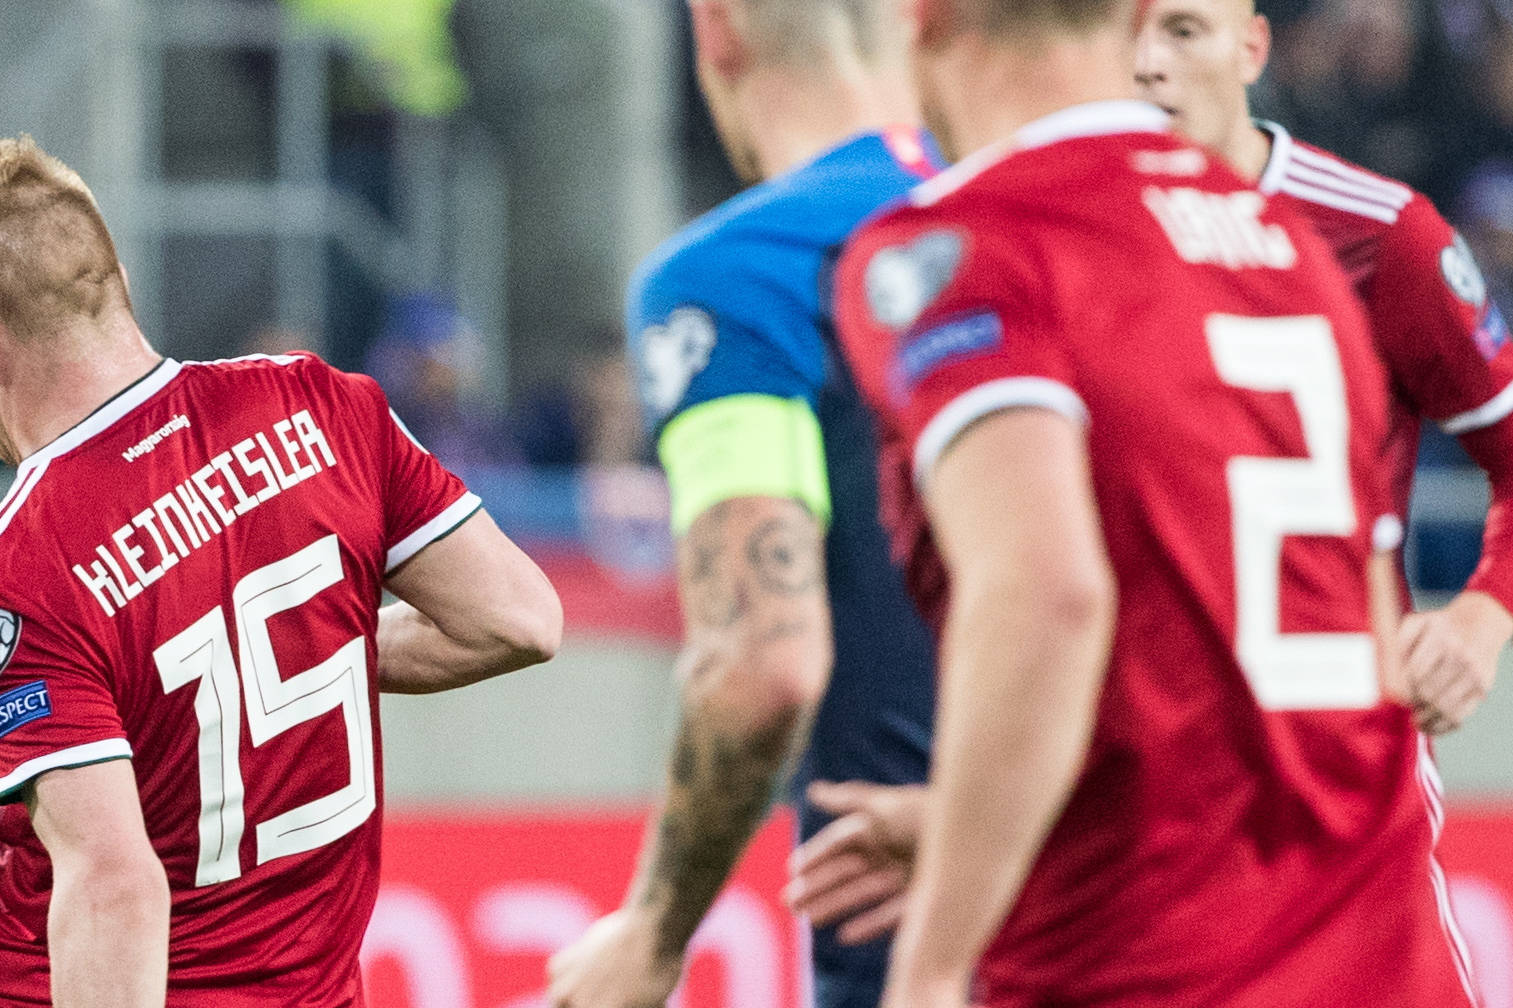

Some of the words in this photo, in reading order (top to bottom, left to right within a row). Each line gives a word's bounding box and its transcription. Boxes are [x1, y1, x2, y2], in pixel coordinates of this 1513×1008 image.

[72, 409, 337, 617] KLEINHEISLER
[1205, 314, 1379, 710] 2
[152, 534, 376, 888] 15
